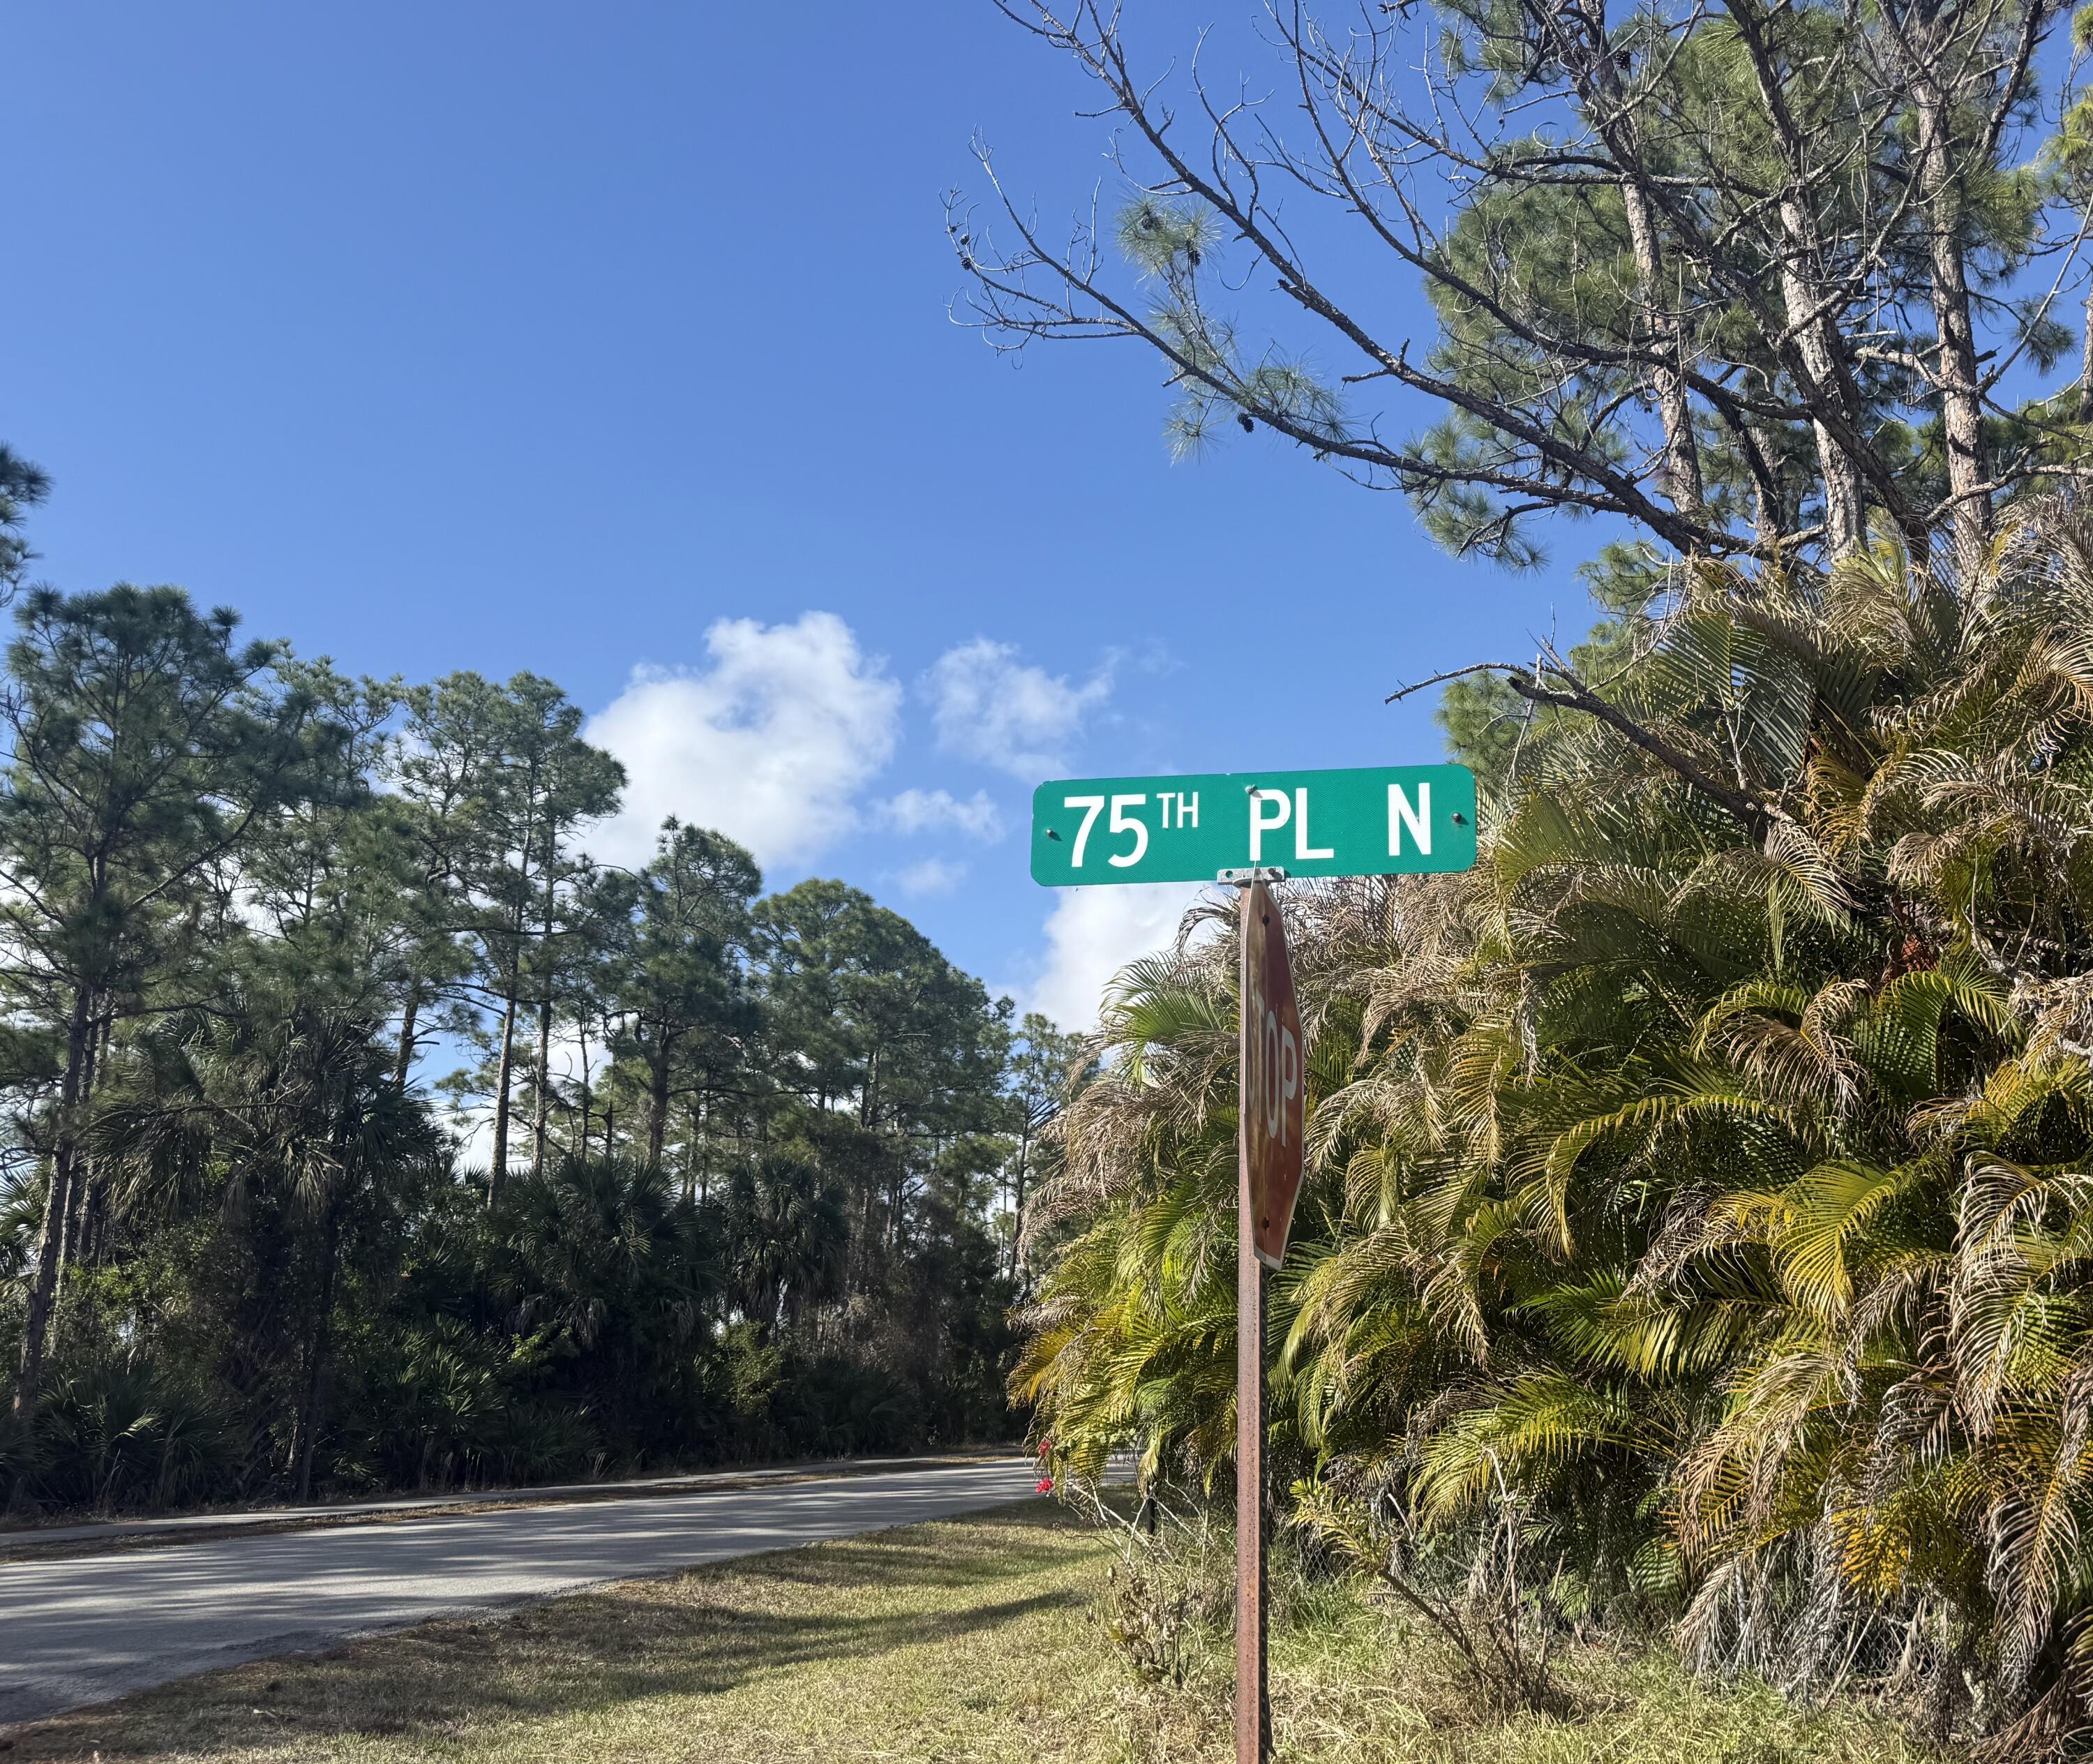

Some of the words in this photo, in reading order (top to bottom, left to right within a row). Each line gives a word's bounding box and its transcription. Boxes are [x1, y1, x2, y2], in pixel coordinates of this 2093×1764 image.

[1064, 791, 1199, 867] 75TH
[1249, 787, 1334, 861] PL
[1388, 782, 1431, 855] N
